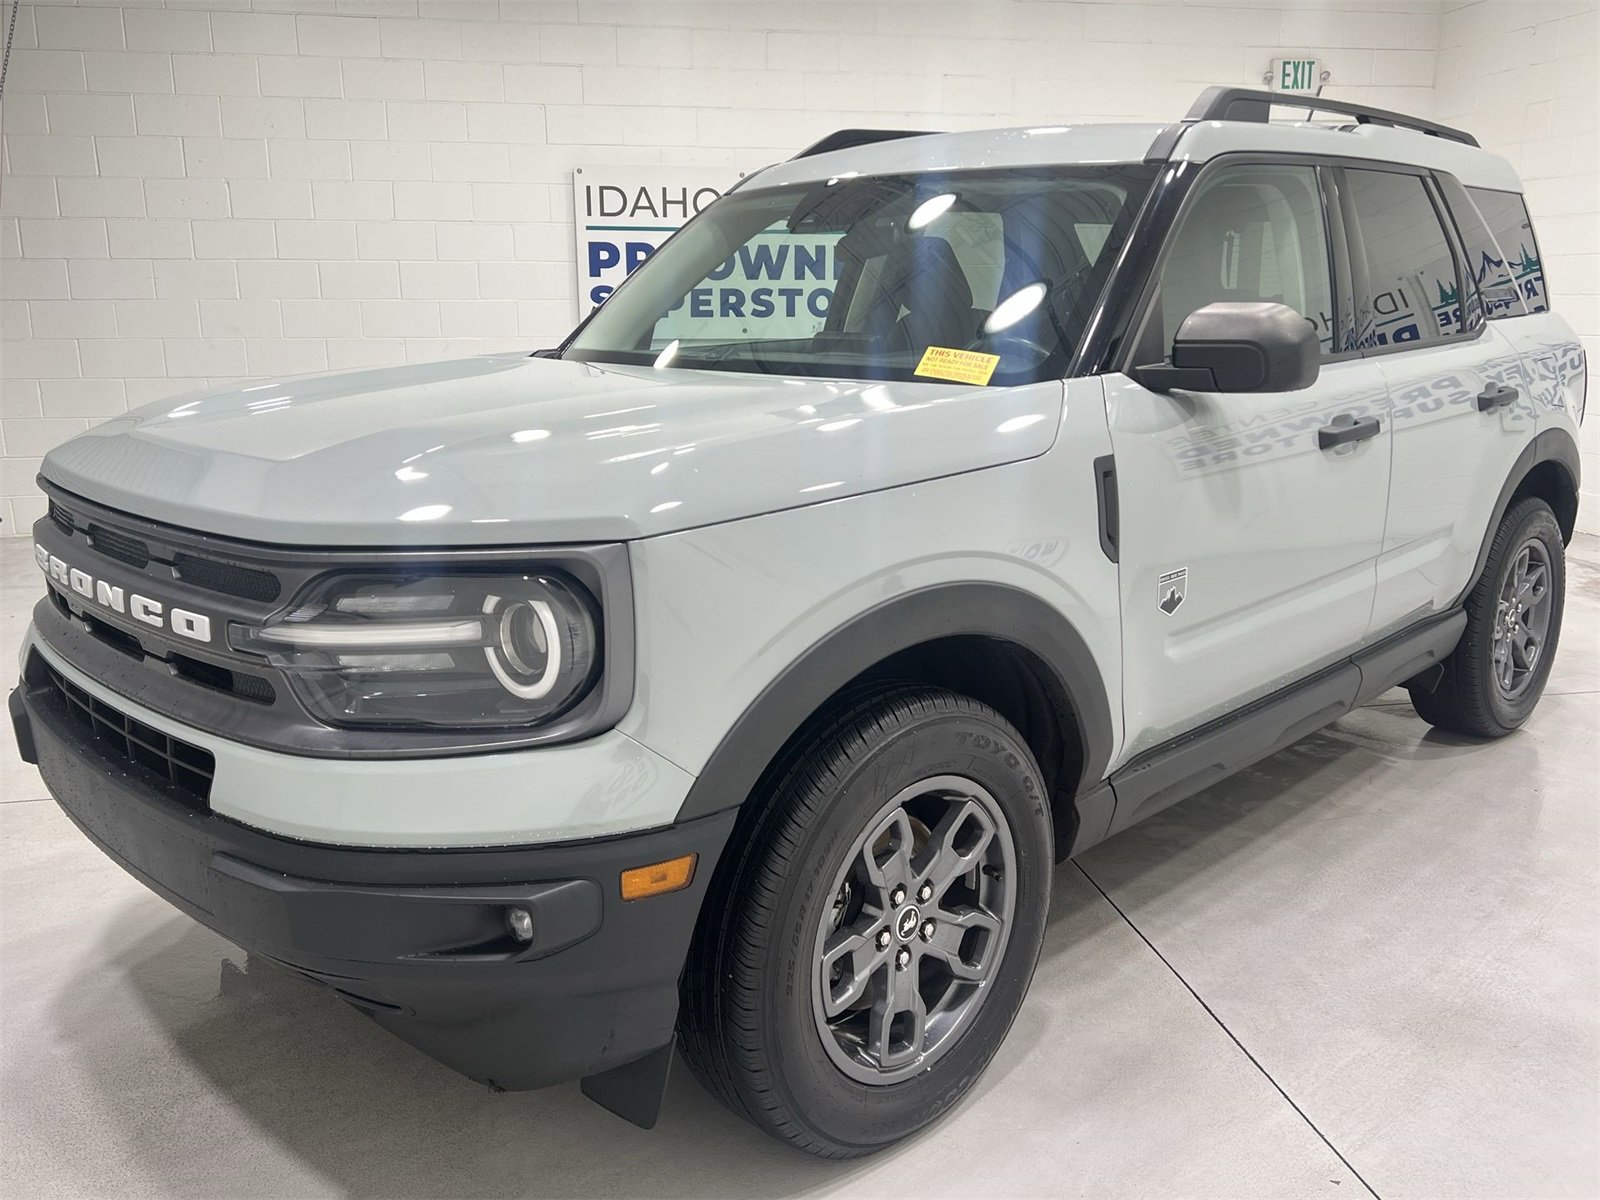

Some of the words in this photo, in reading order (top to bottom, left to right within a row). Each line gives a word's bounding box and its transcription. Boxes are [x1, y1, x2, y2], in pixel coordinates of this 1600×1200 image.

[1281, 60, 1316, 90] EXIT
[585, 185, 722, 218] IDAHO
[930, 348, 951, 358] THIS
[953, 350, 994, 363] VEHICLE
[942, 357, 960, 365] READY
[960, 359, 973, 367] FOR
[973, 361, 988, 370] SALE
[34, 543, 212, 643] BRONCO
[955, 731, 1020, 771] TOYO
